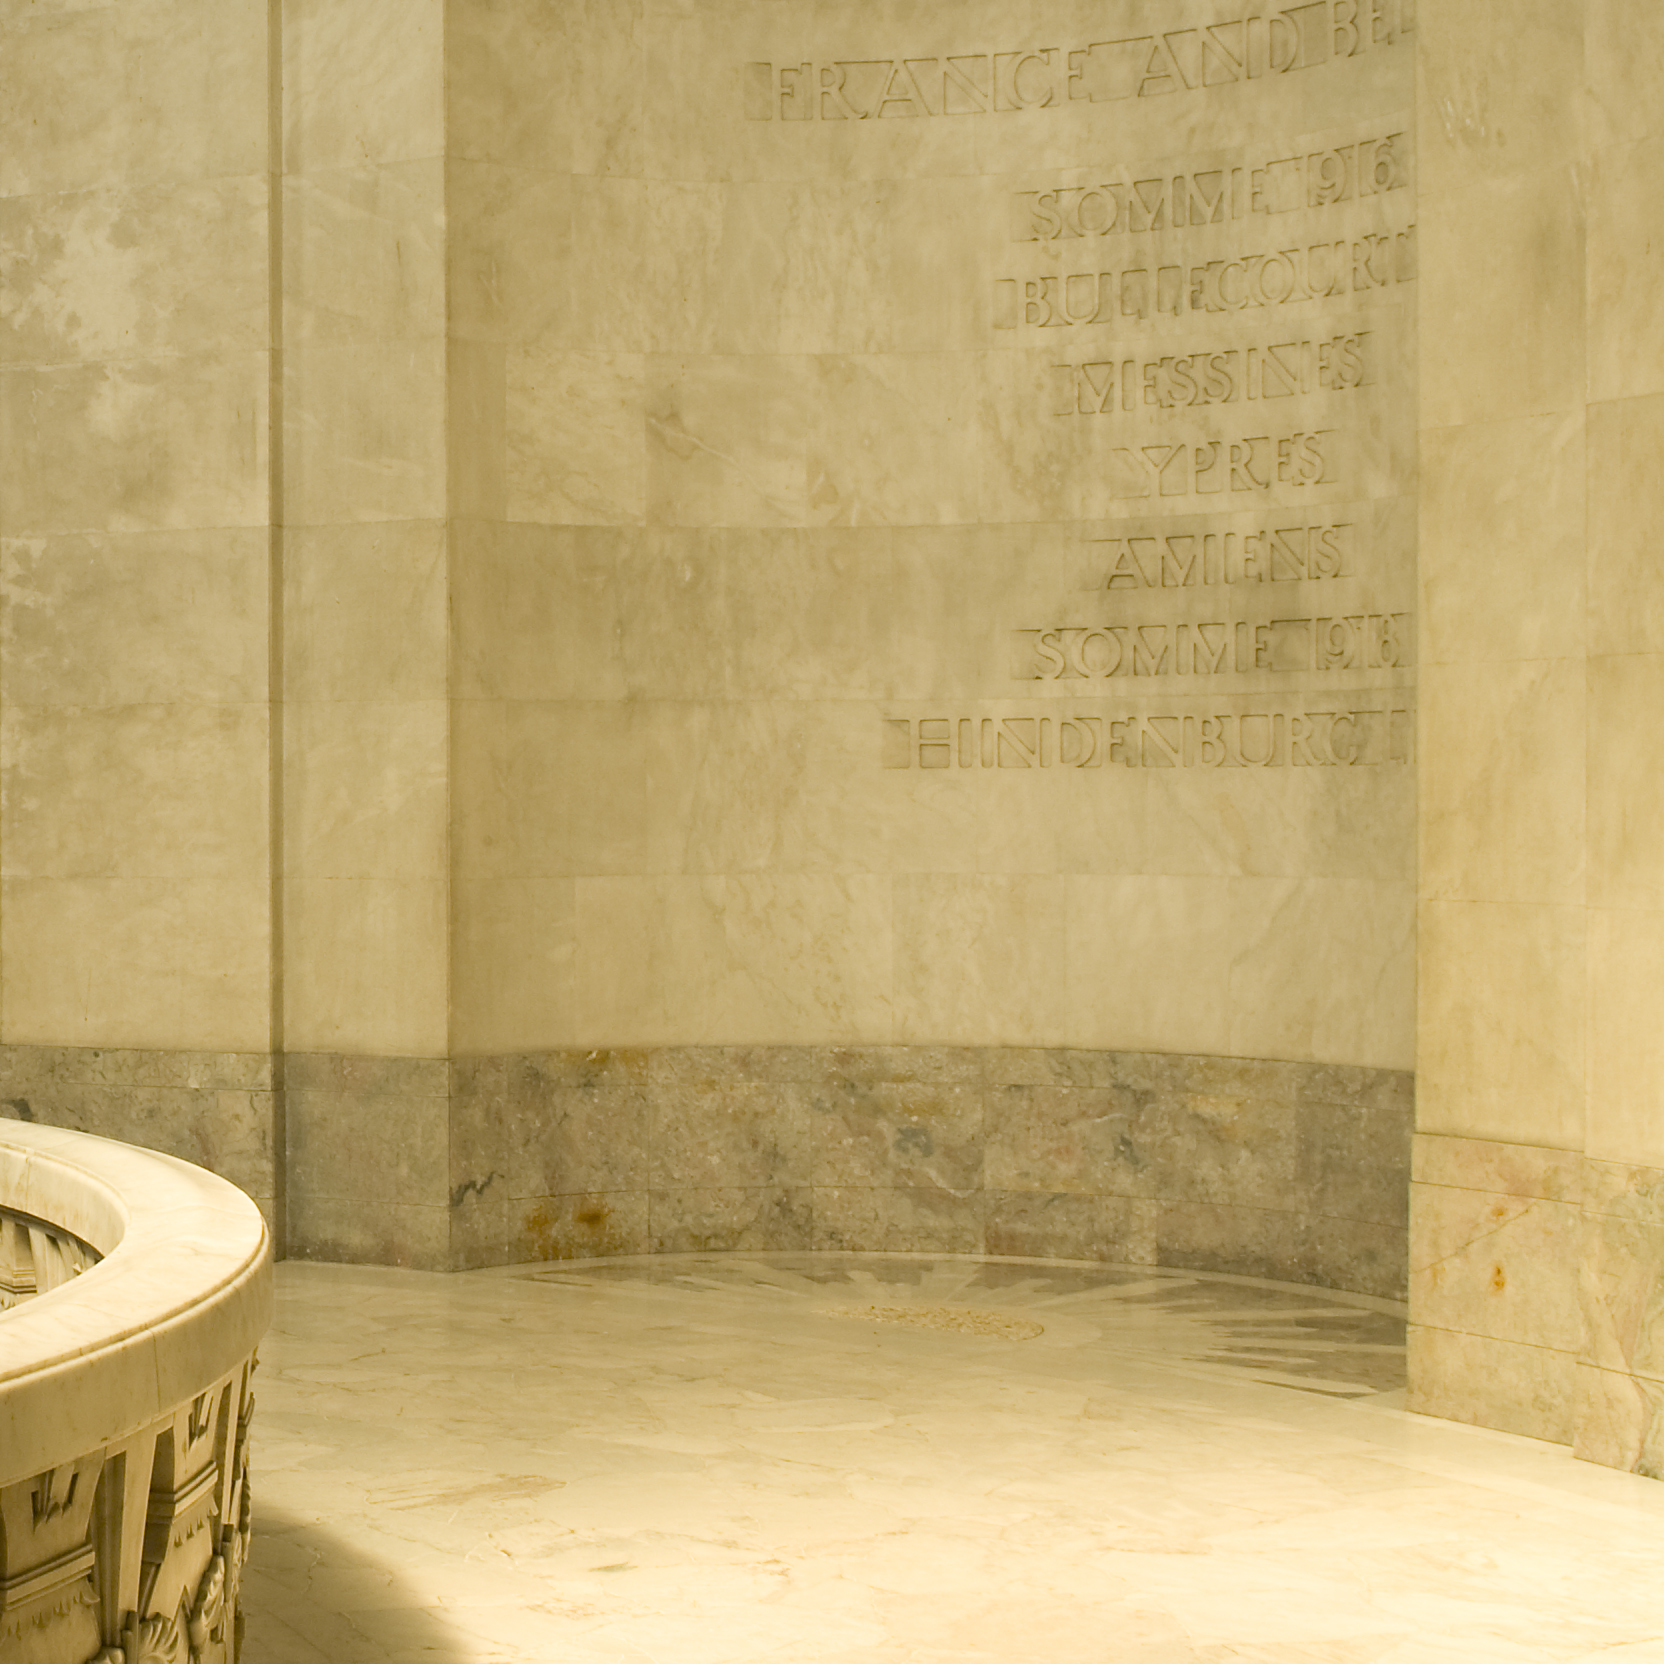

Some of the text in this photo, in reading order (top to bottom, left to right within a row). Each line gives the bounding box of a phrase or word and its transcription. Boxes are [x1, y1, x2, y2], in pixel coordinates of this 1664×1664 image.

[770, 47, 1093, 121] FRANCE
[1134, 12, 1300, 98] AND
[1031, 134, 1397, 241] SOMME 1916
[1015, 226, 1410, 328] BULLECOURT
[1071, 333, 1366, 415] MESSINES
[1125, 432, 1326, 498] YPRES
[1102, 525, 1342, 590] AMIENS
[1035, 614, 1399, 680] SOMME 1918
[910, 712, 1362, 769] HINDENBURG
